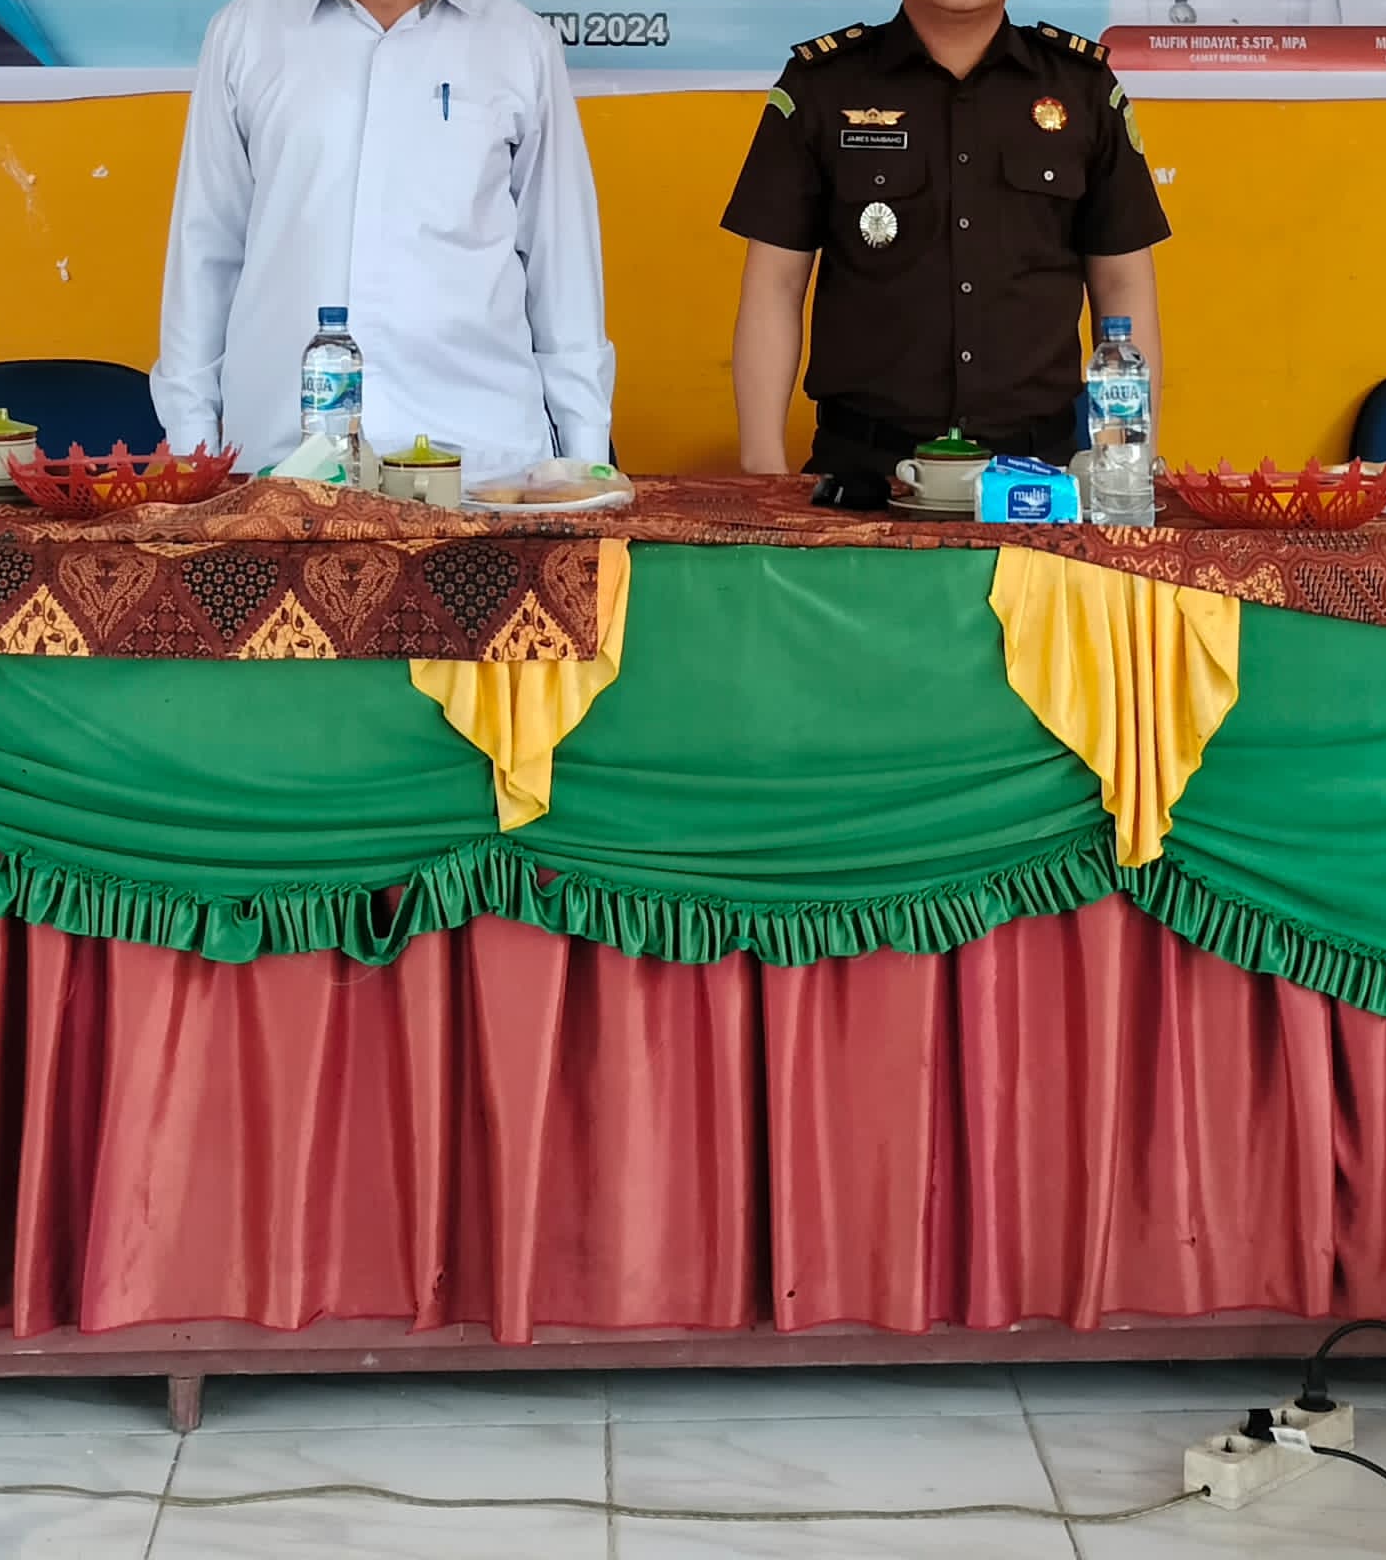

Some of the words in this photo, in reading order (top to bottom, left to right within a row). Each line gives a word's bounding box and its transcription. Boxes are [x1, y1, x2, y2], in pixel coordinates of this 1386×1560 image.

[584, 12, 670, 46] 2024
[1149, 36, 1188, 49] TAUFIK
[1191, 36, 1240, 51] HIDAYAT,
[1282, 36, 1307, 49] MPA
[1100, 385, 1139, 402] AQUA
